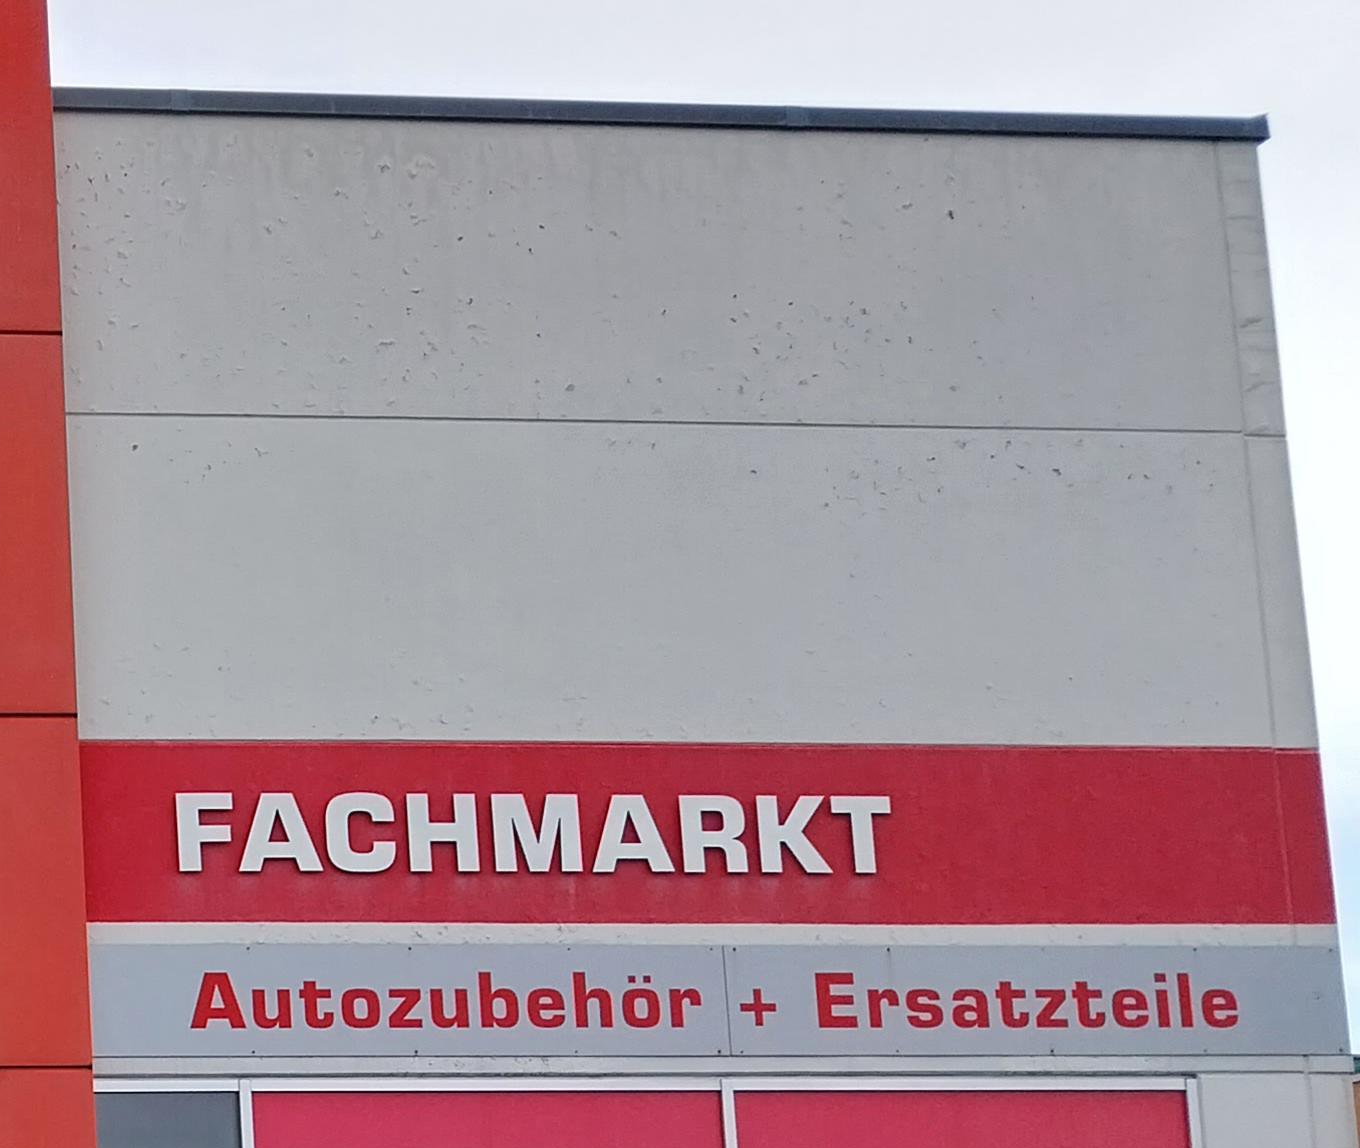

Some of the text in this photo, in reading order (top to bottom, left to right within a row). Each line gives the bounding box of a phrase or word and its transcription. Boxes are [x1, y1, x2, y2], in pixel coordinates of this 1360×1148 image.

[175, 792, 891, 874] FACHMARKT
[190, 971, 1239, 1029] Autozubehör + Ersatzteile
